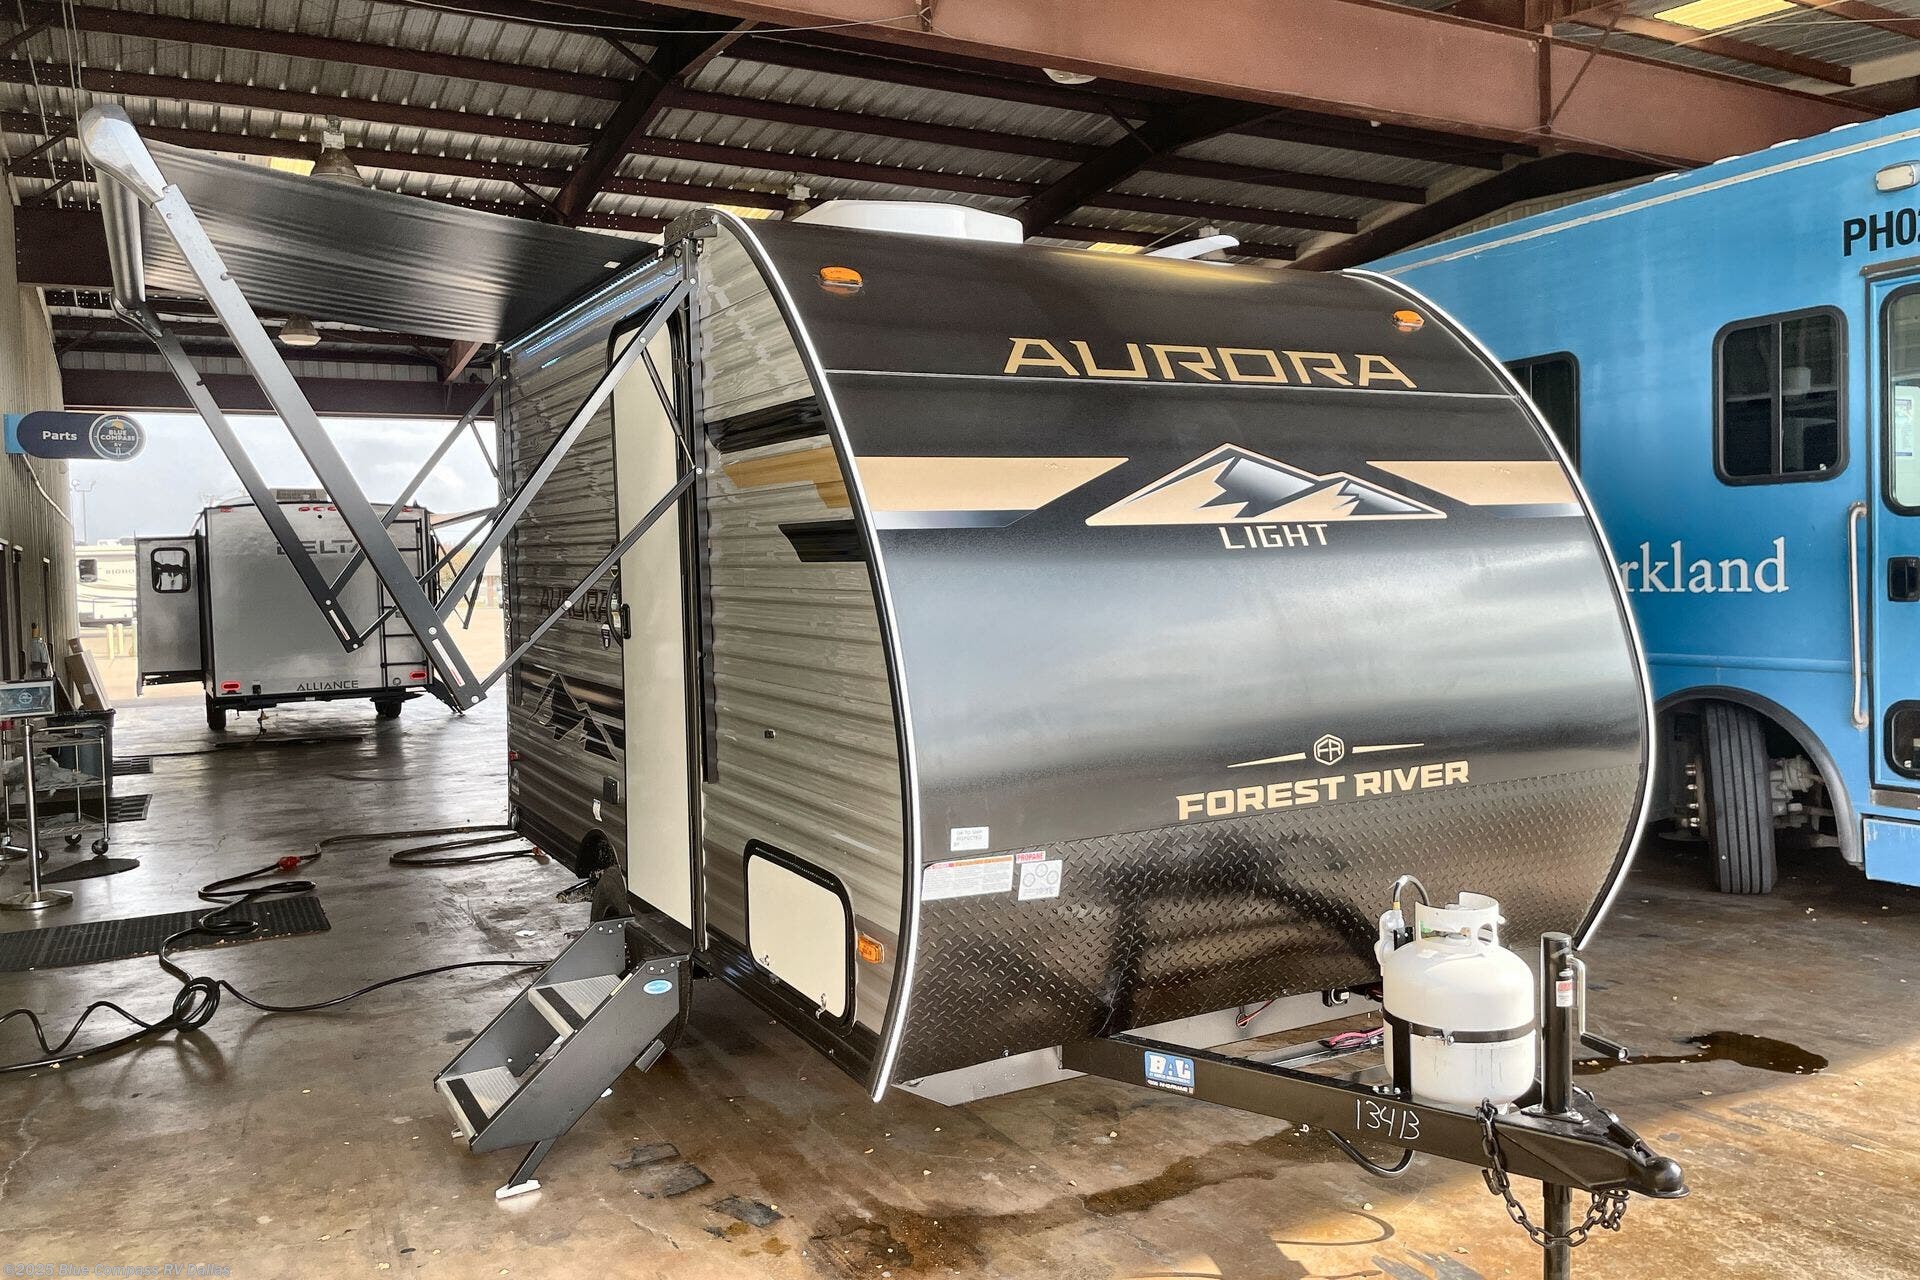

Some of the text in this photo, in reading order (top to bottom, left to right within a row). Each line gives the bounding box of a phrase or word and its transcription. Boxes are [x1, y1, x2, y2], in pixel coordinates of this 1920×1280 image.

[1843, 208, 1920, 257] PH0
[1004, 337, 1417, 388] AURORA
[42, 430, 78, 441] Parts
[1218, 524, 1329, 549] LIGHT
[277, 540, 360, 555] ELT
[296, 680, 359, 691] ALLIANCE
[1176, 760, 1470, 821] FOREST RIVER
[1016, 851, 1044, 862] PROPANE
